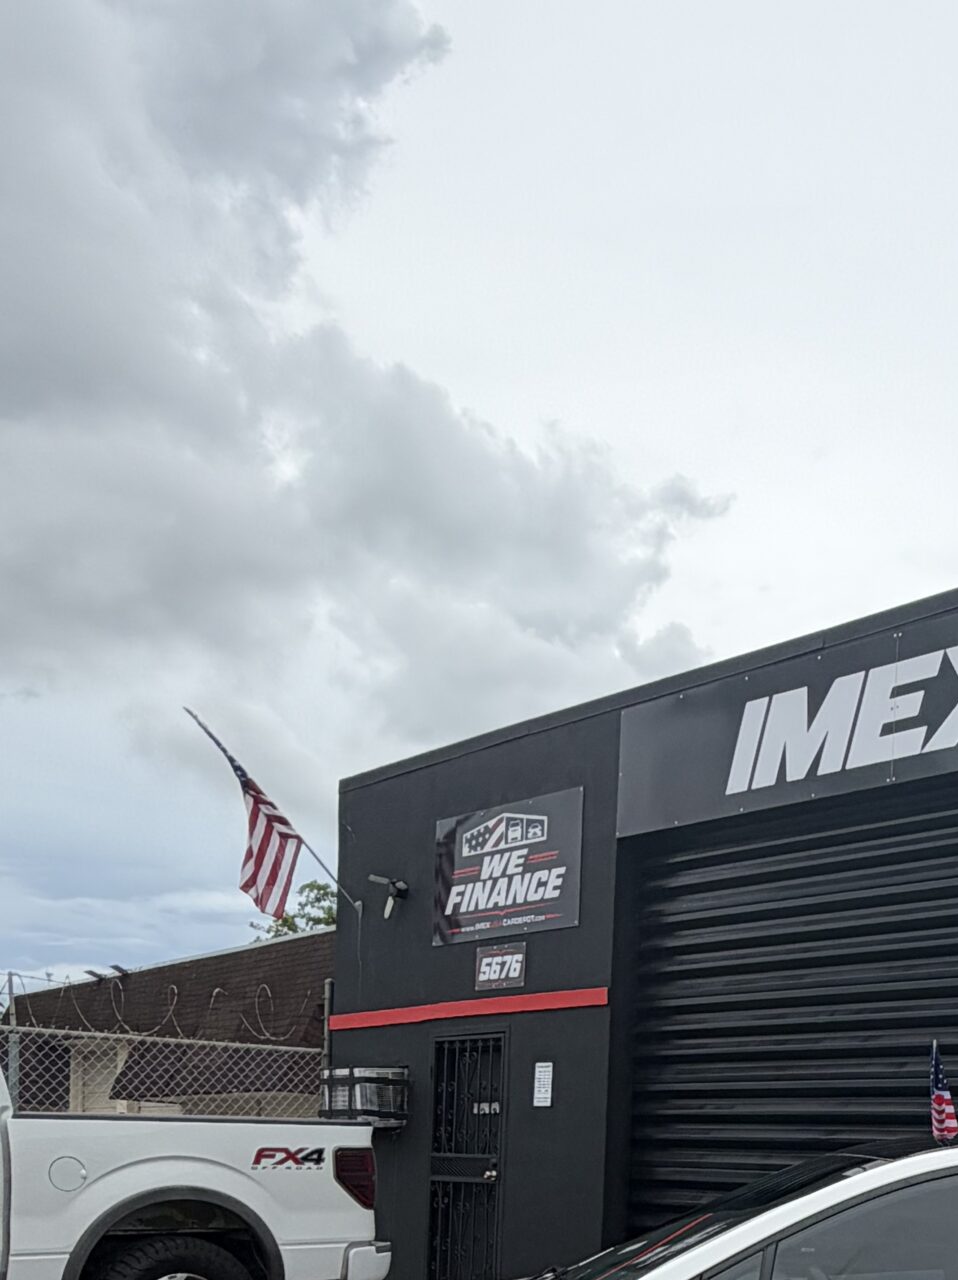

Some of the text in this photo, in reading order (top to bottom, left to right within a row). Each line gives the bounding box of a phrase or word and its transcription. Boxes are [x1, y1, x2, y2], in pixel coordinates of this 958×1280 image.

[480, 848, 528, 880] WE
[444, 866, 567, 916] FINANCE
[478, 953, 523, 981] 5676
[252, 1147, 325, 1165] FX4
